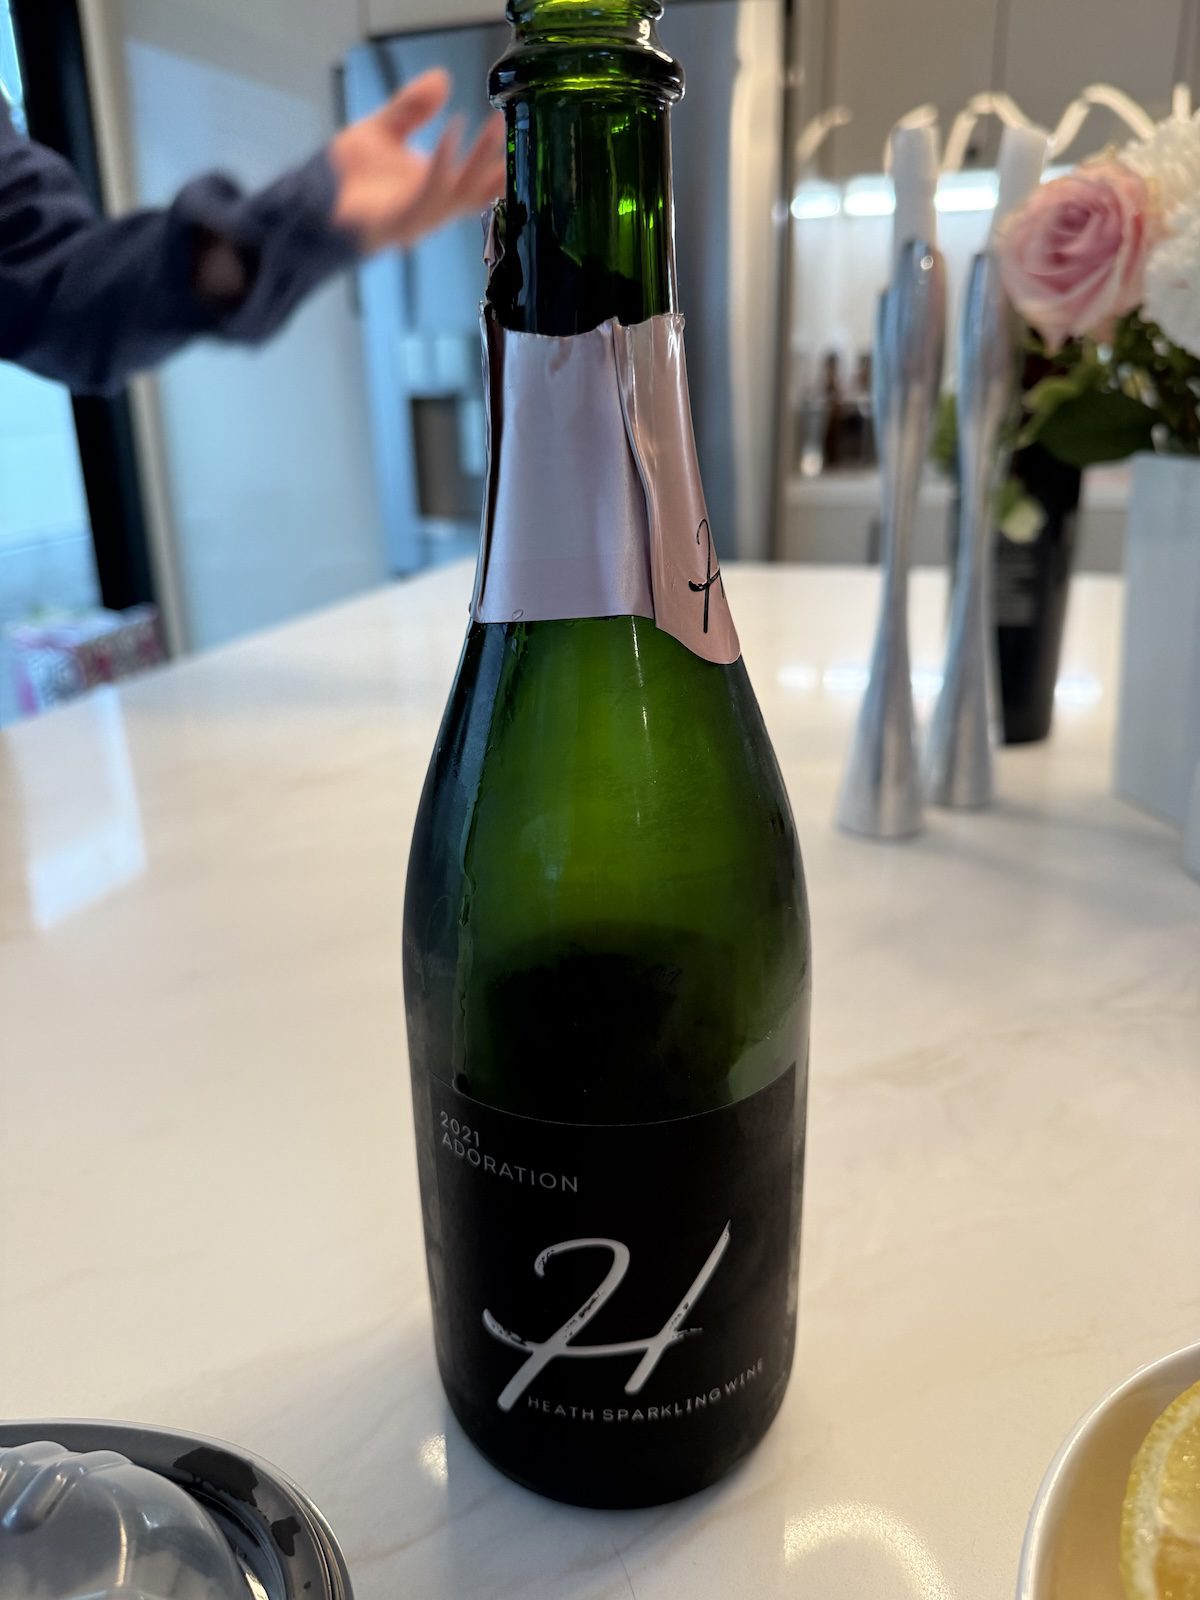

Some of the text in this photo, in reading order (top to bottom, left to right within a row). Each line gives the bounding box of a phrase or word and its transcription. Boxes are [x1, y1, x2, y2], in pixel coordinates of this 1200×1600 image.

[440, 1111, 480, 1147] 2021
[442, 1132, 578, 1193] ADORATION
[528, 1358, 764, 1422] HEATH SPARKLING WINE
